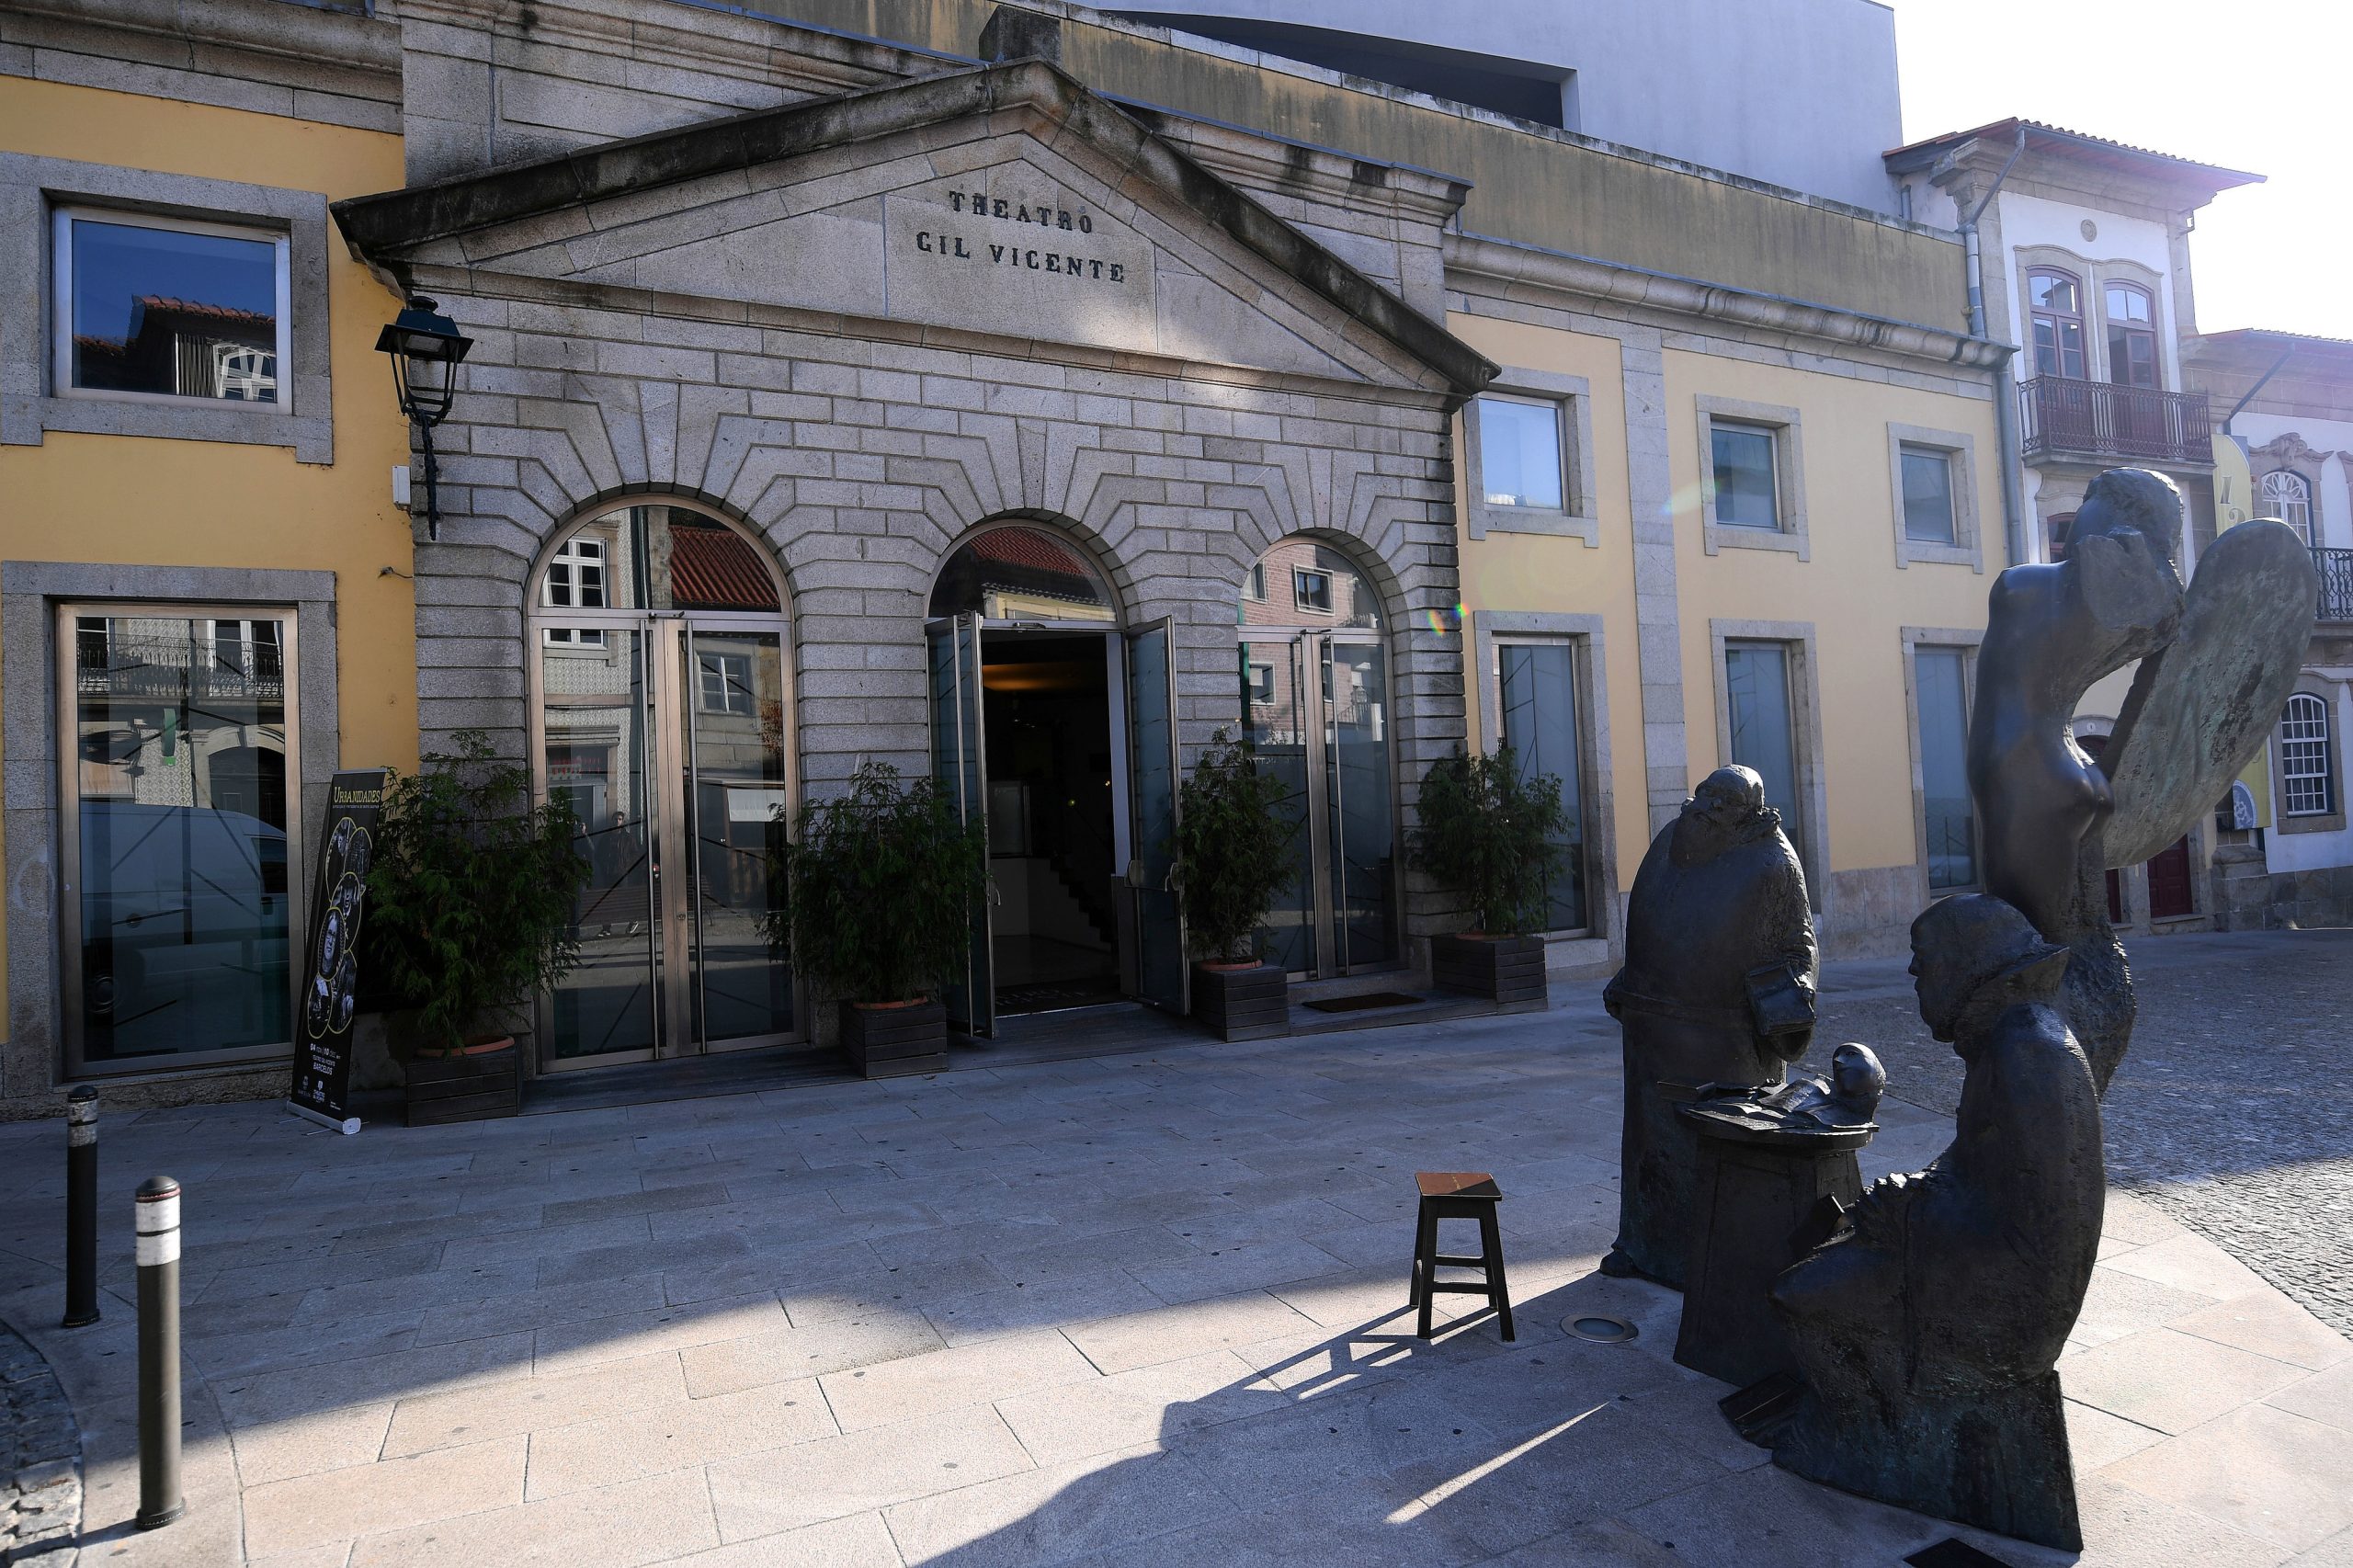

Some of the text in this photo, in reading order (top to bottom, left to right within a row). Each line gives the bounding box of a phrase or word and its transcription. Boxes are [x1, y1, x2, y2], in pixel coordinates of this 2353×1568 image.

[949, 190, 1093, 233] THEATRO
[915, 231, 1125, 283] GIL VICENTE
